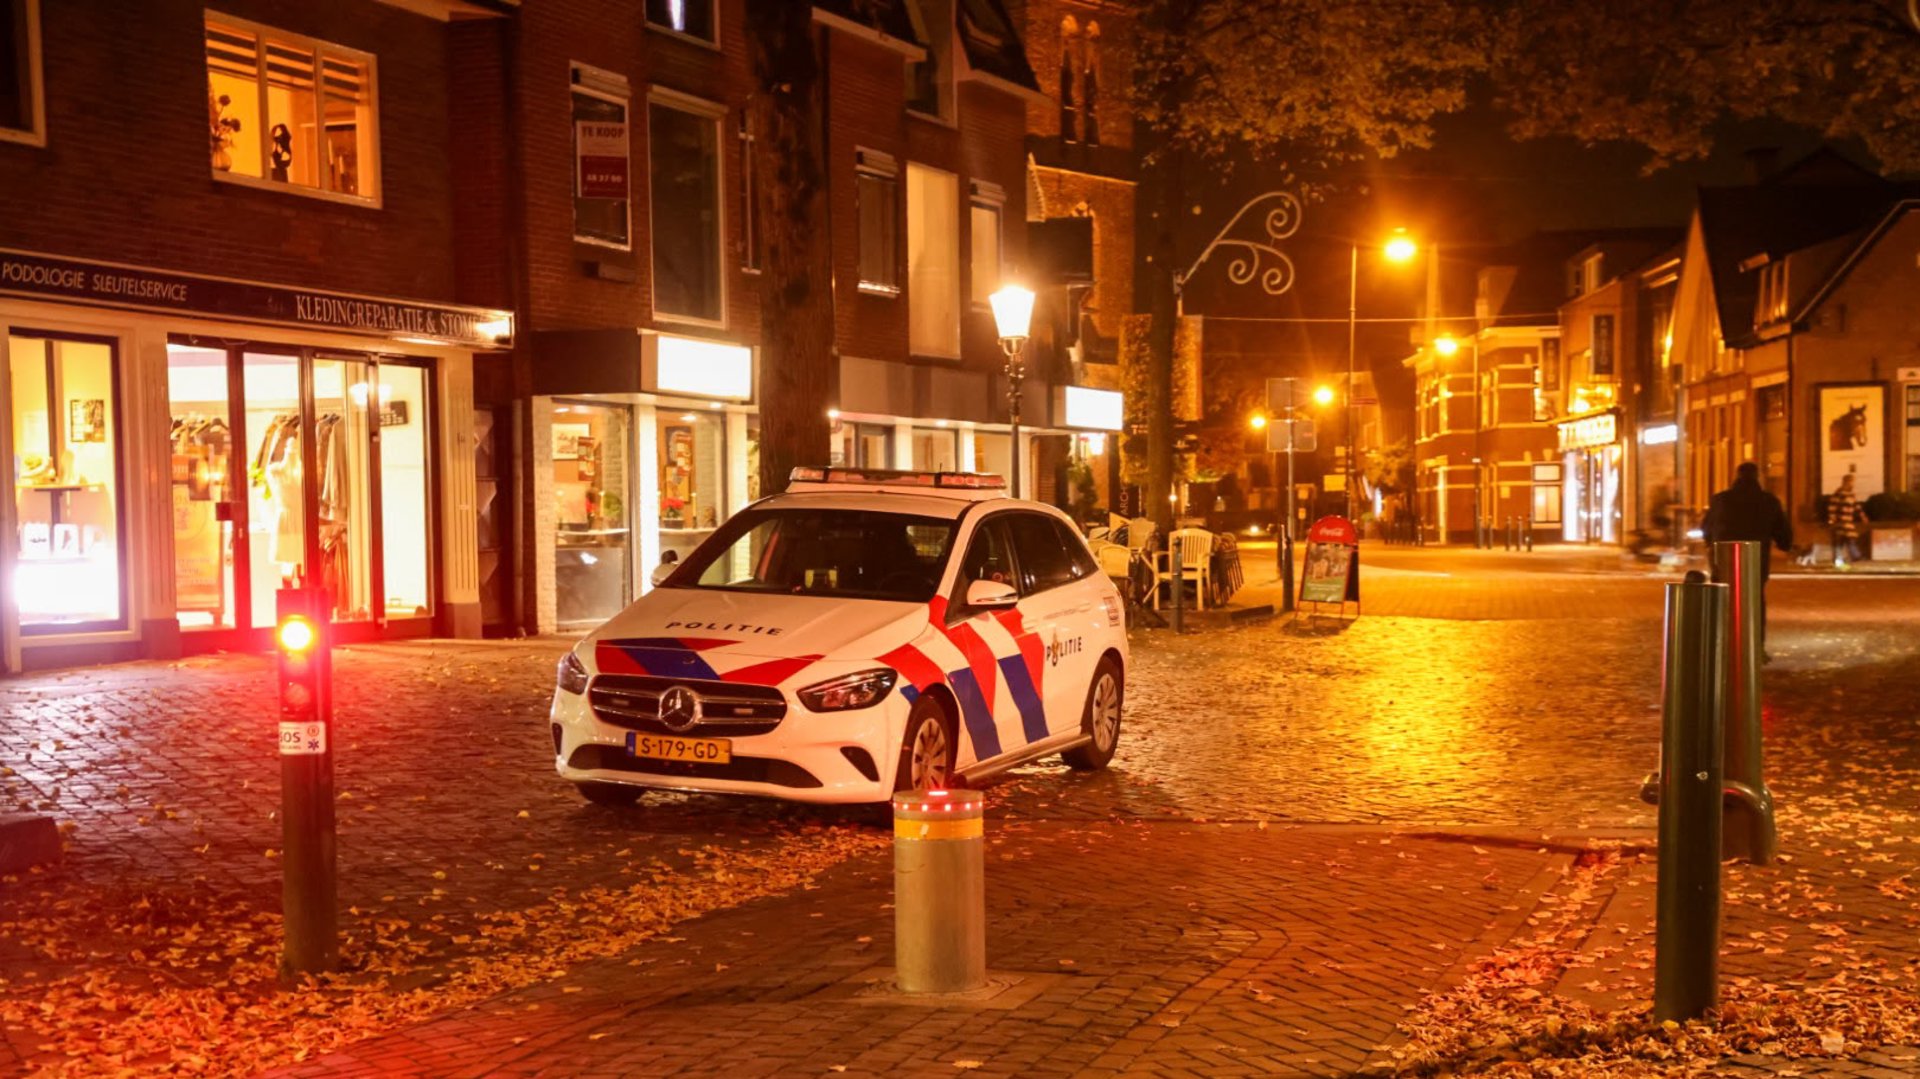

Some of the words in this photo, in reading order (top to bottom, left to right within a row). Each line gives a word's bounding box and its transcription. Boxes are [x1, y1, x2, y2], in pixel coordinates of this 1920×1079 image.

[2, 261, 86, 289] PODOLOGIE
[92, 273, 188, 302] SLEUTELSERVICE
[295, 294, 423, 333] KLEDINGREPARATIE
[425, 310, 437, 334] &
[665, 622, 783, 636] POLITIE
[641, 737, 719, 759] S-179-GD
